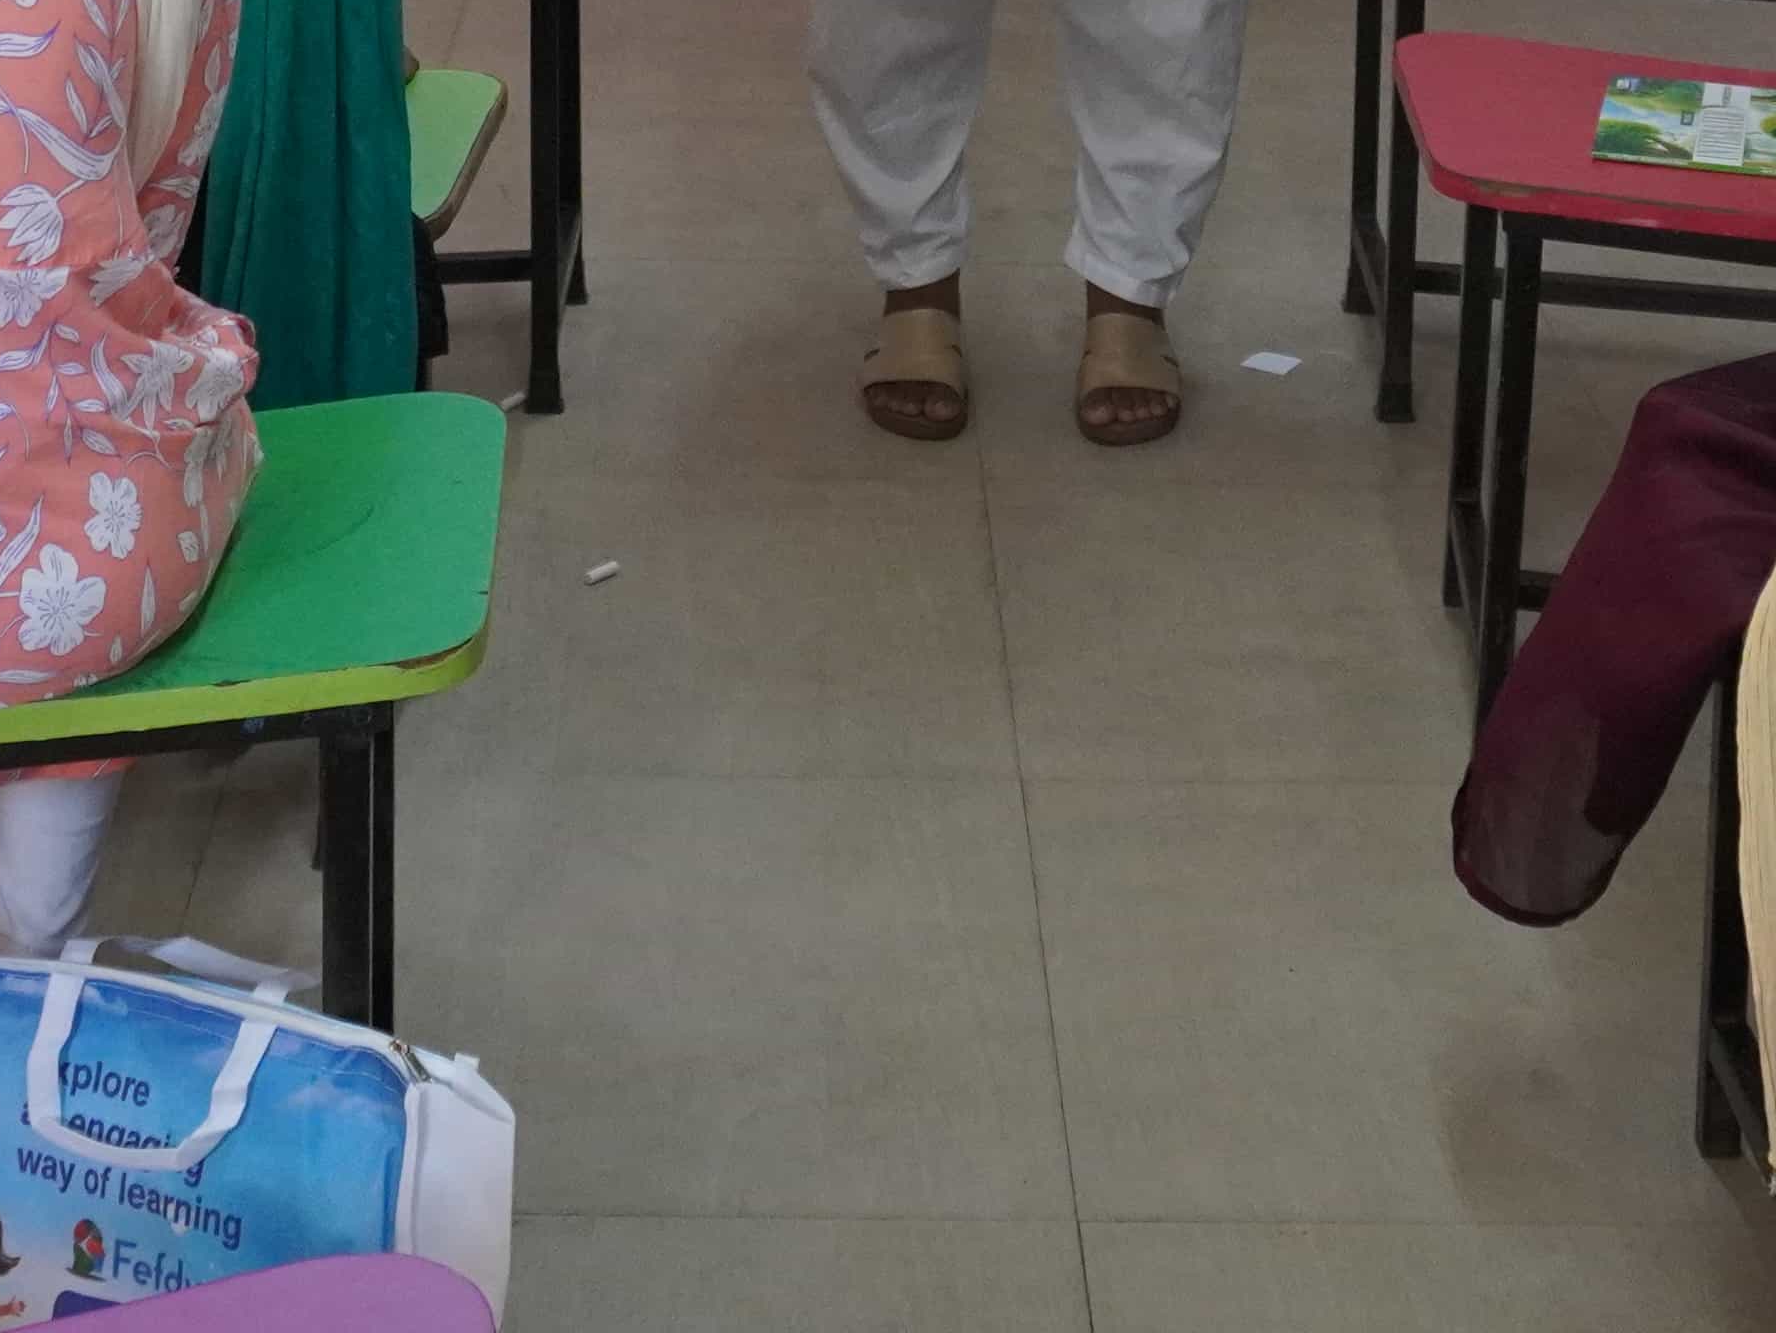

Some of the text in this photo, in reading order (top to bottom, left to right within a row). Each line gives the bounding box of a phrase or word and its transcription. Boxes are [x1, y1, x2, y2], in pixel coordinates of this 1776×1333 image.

[58, 1060, 151, 1107] xplore
[17, 1147, 243, 1252] way of learning
